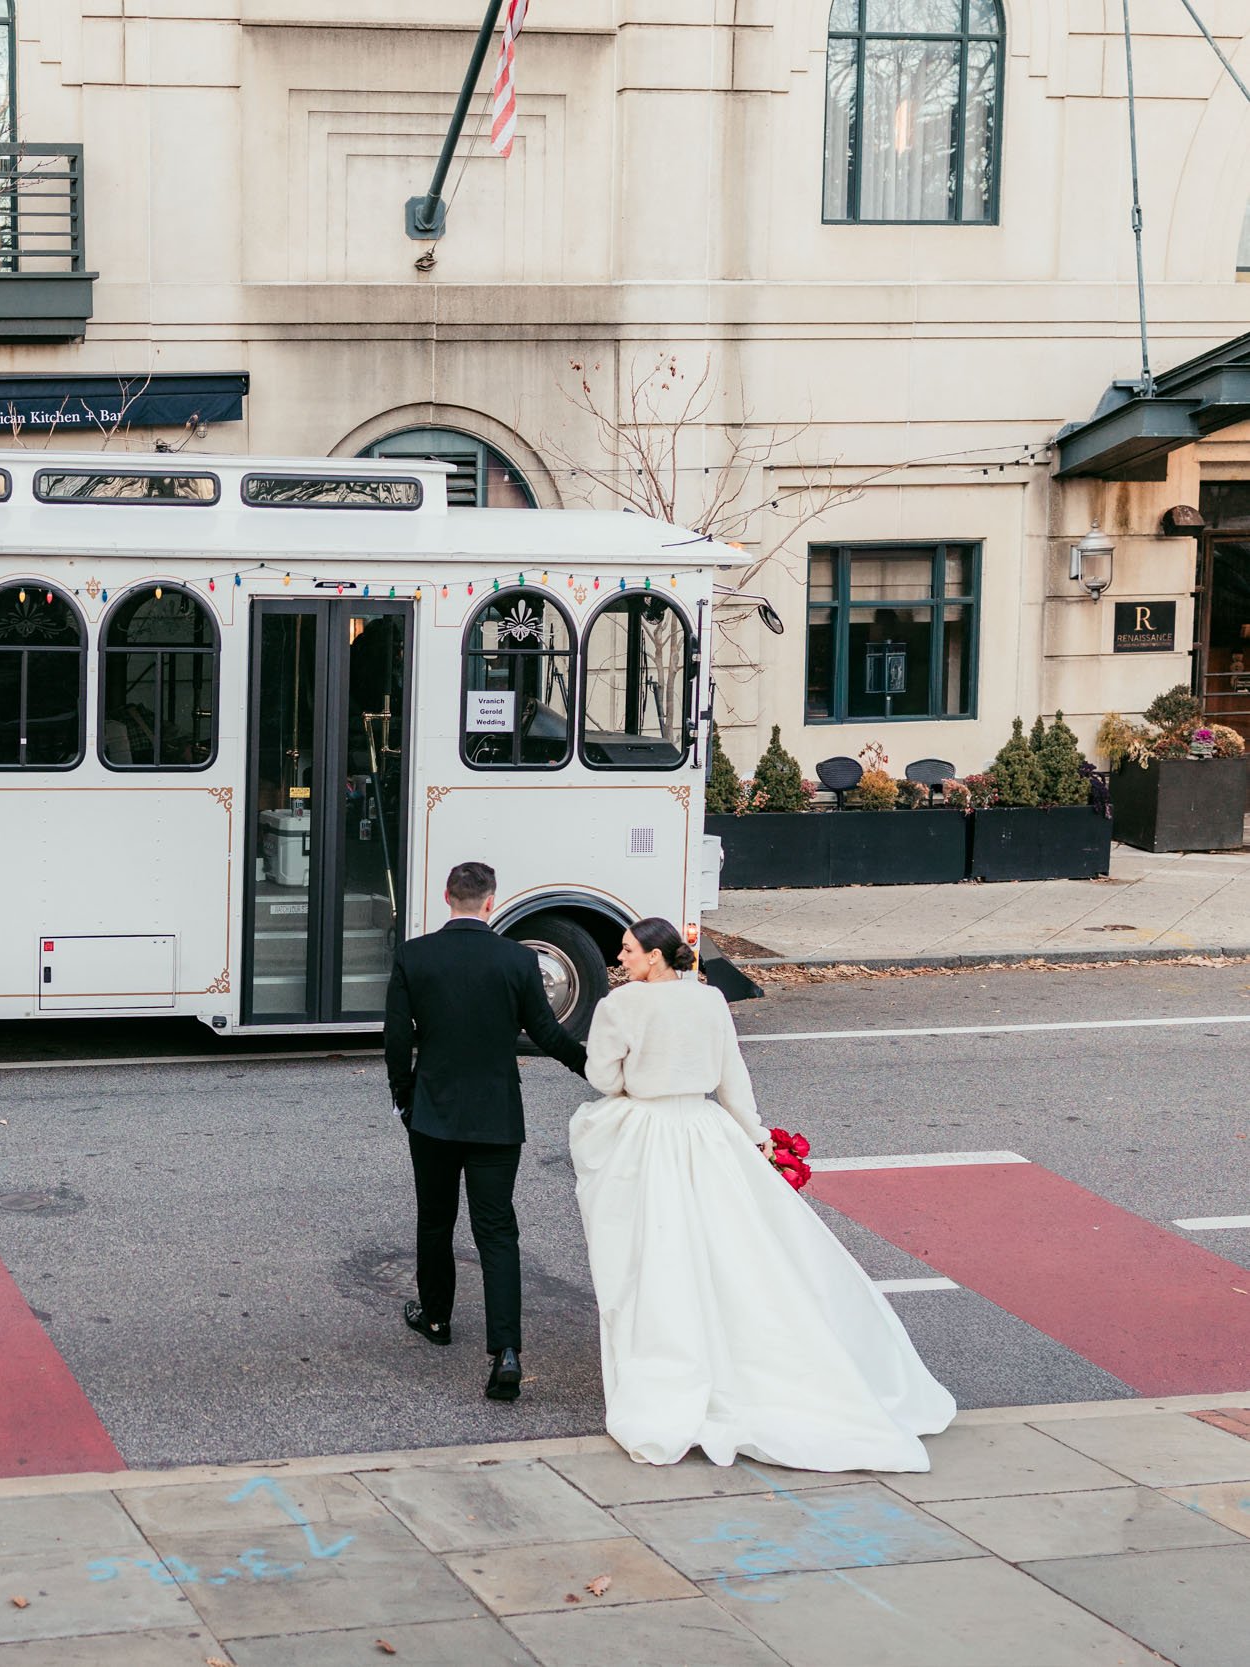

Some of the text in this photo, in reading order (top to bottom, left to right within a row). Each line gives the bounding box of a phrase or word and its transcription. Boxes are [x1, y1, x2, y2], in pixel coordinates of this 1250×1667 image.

[30, 411, 80, 424] Kitchen
[100, 409, 124, 422] Bar
[1134, 606, 1157, 631] R
[1117, 633, 1173, 642] RENAISSANCE
